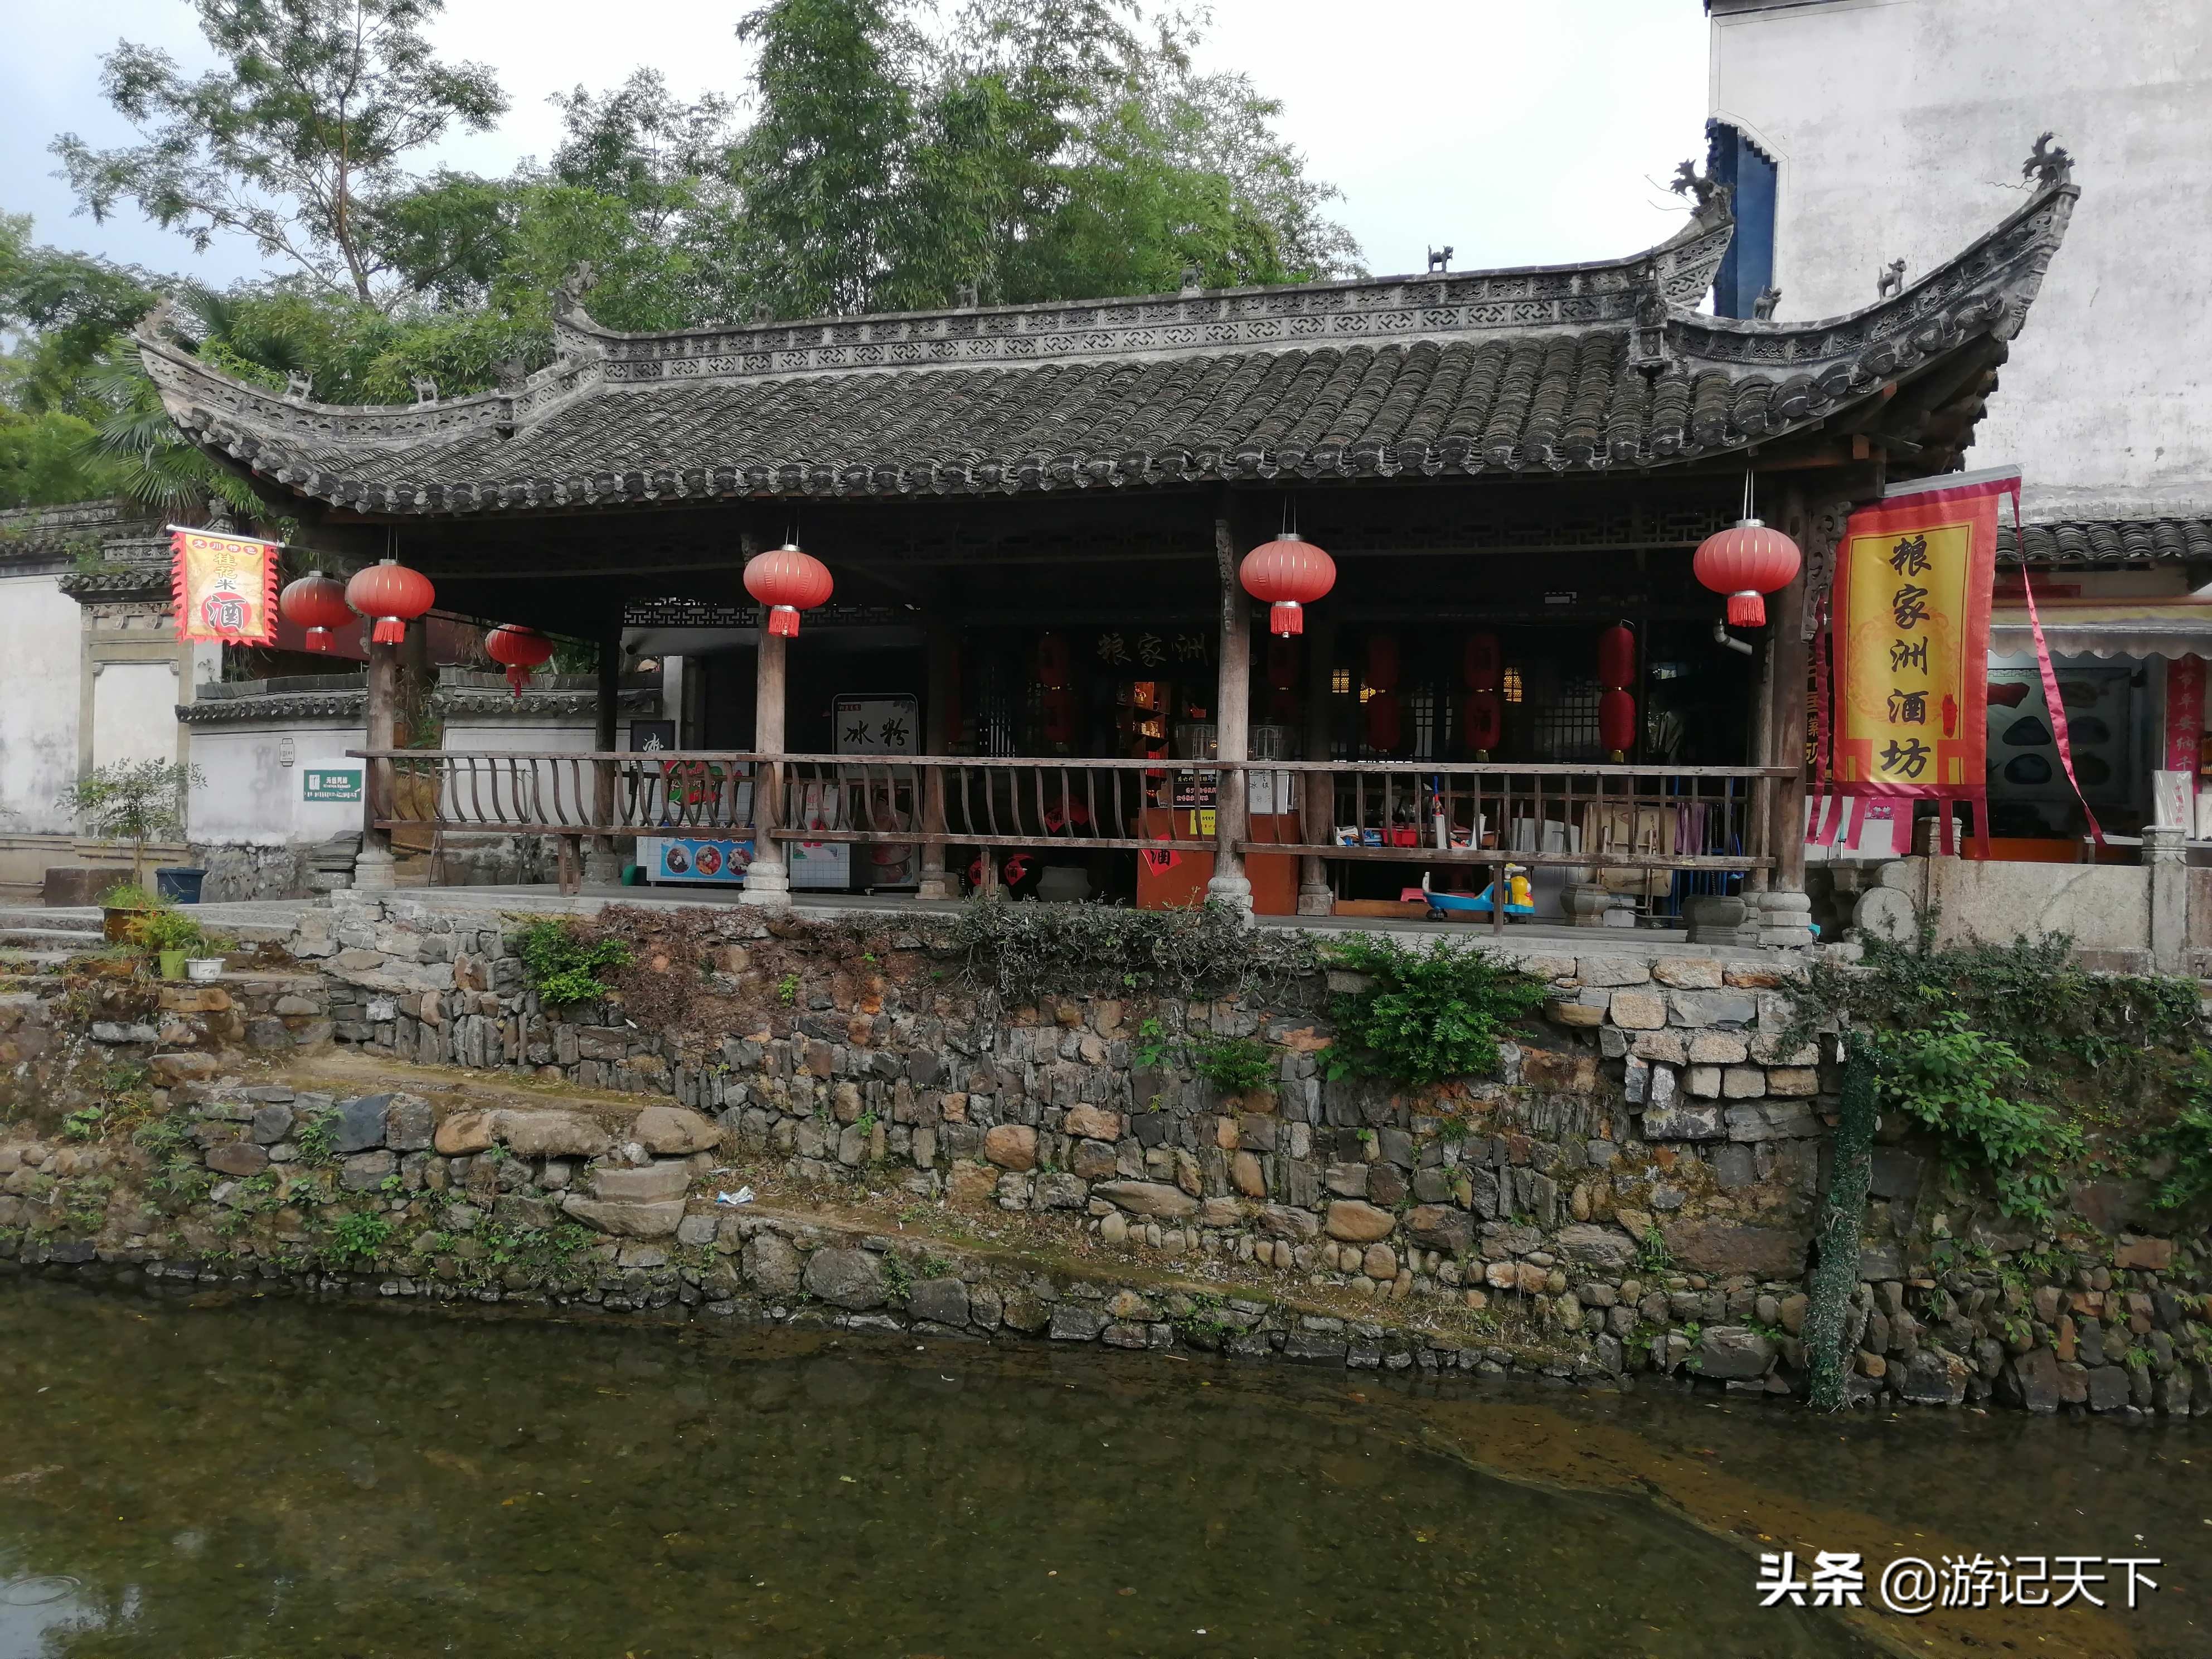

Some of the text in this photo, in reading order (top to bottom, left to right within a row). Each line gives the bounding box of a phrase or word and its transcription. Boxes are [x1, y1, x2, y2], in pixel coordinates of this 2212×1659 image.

[193, 540, 257, 555] 龙川特色
[1880, 535, 1932, 779] 粮家洲酒坊
[843, 717, 910, 748] 冰粉
